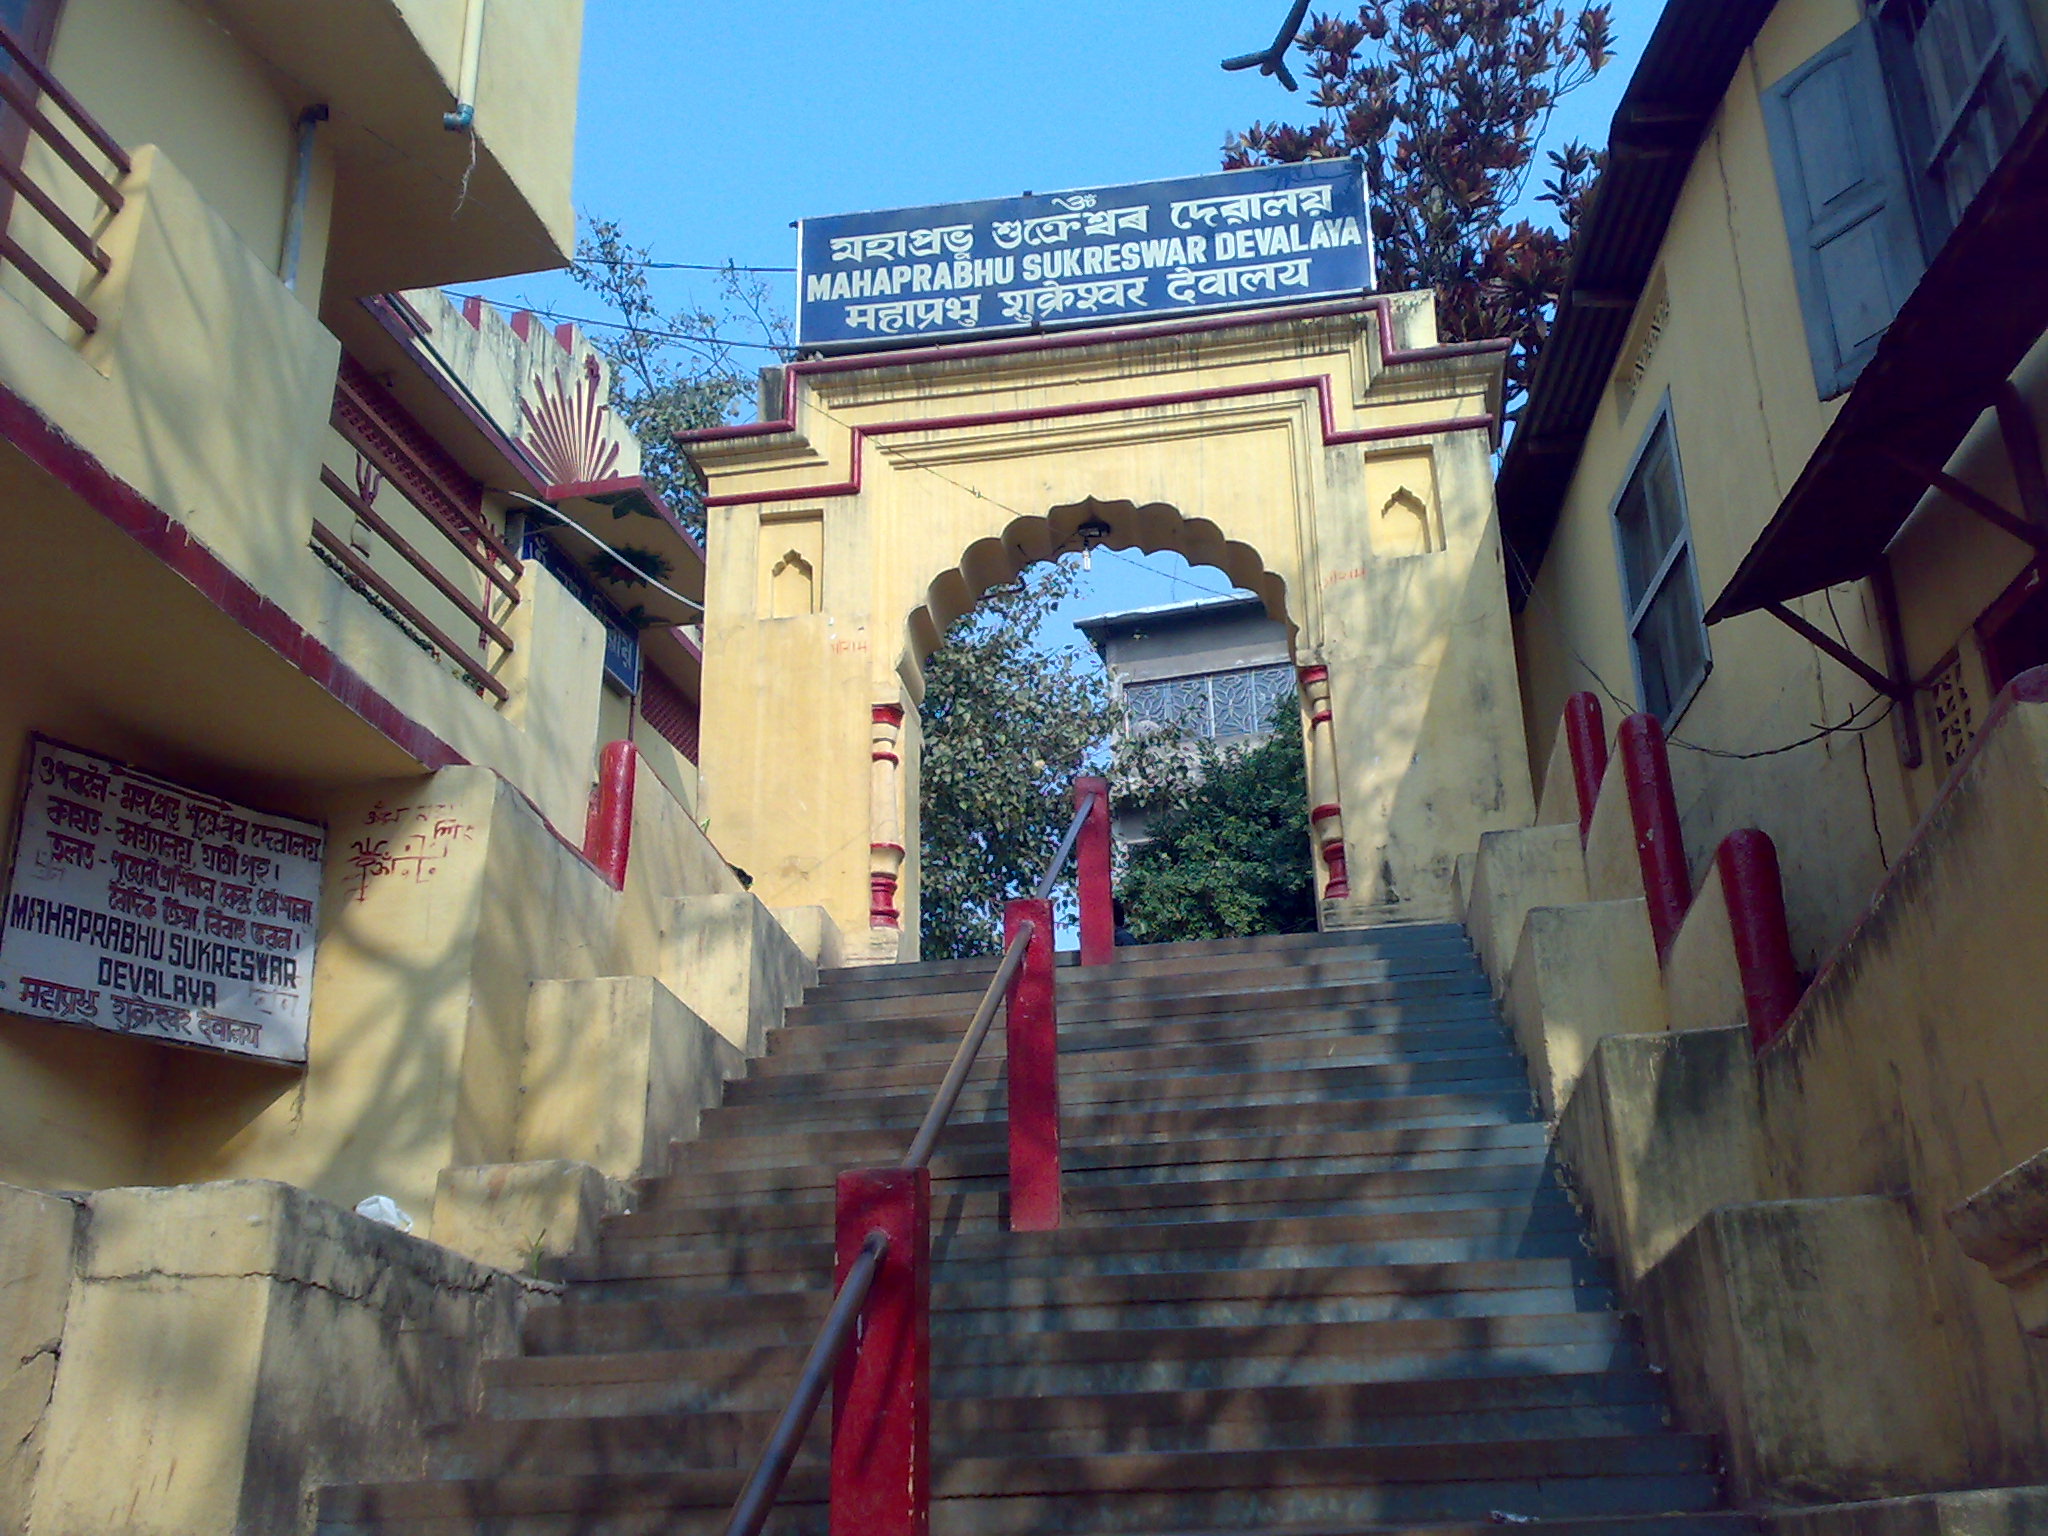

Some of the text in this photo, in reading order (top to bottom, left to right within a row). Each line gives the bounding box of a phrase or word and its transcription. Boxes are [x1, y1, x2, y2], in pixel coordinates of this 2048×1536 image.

[807, 217, 1362, 303] MAHAPRABHU SUKRESWAR DEVALAYA
[845, 258, 1312, 333] महाप्रभु शुक्रेश्वर देवालय
[10, 893, 297, 989] MAHAPRABHU SUKRESWAR
[97, 957, 216, 1009] DEVALAYA
